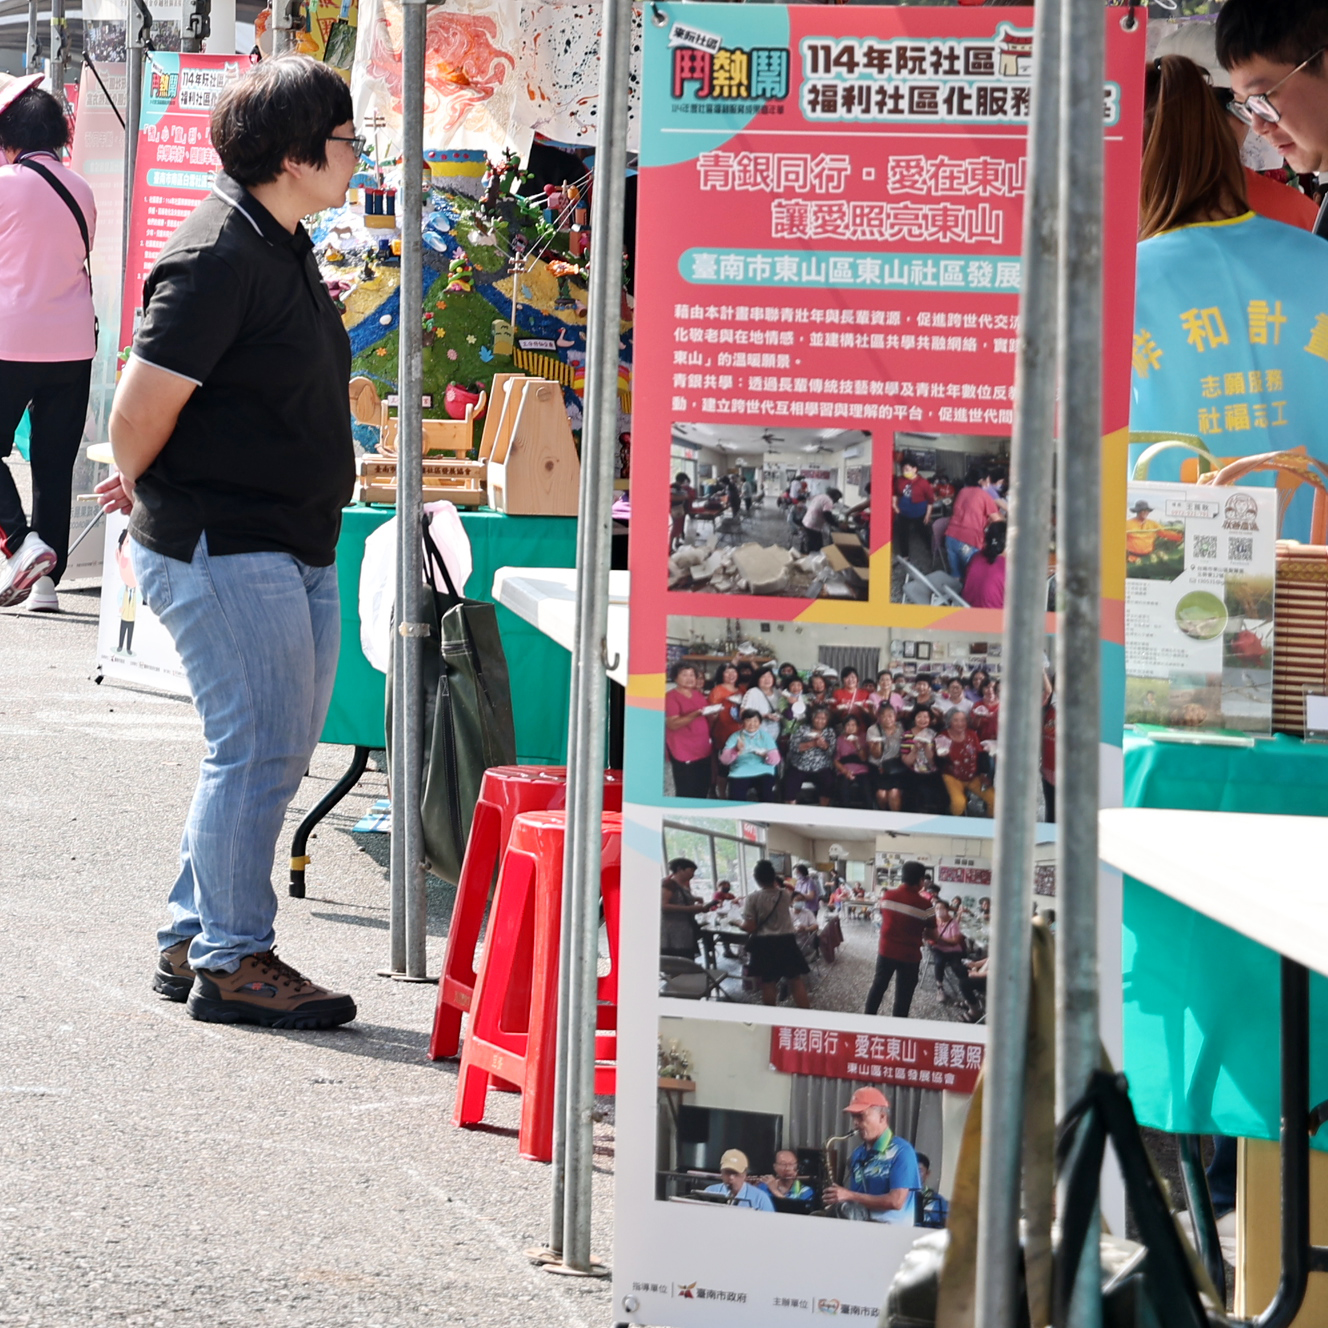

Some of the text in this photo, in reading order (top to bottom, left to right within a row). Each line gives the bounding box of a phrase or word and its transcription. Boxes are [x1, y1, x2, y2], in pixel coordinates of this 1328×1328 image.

[673, 26, 719, 51] 來阮社區
[672, 47, 790, 100] 鬥熱鬧
[808, 43, 996, 77] 114年阮社區
[807, 84, 1112, 119] 福利社區化服務
[771, 198, 1003, 244] 讓愛照亮東山
[692, 252, 1021, 289] 臺南市東山區東山社區發展
[1200, 369, 1283, 399] 志願服務
[1197, 400, 1289, 435] 社福志工
[847, 1062, 956, 1085] 東山區社區發展協會
[632, 1281, 668, 1294] 指導單位
[696, 1288, 747, 1304] 臺南市政府
